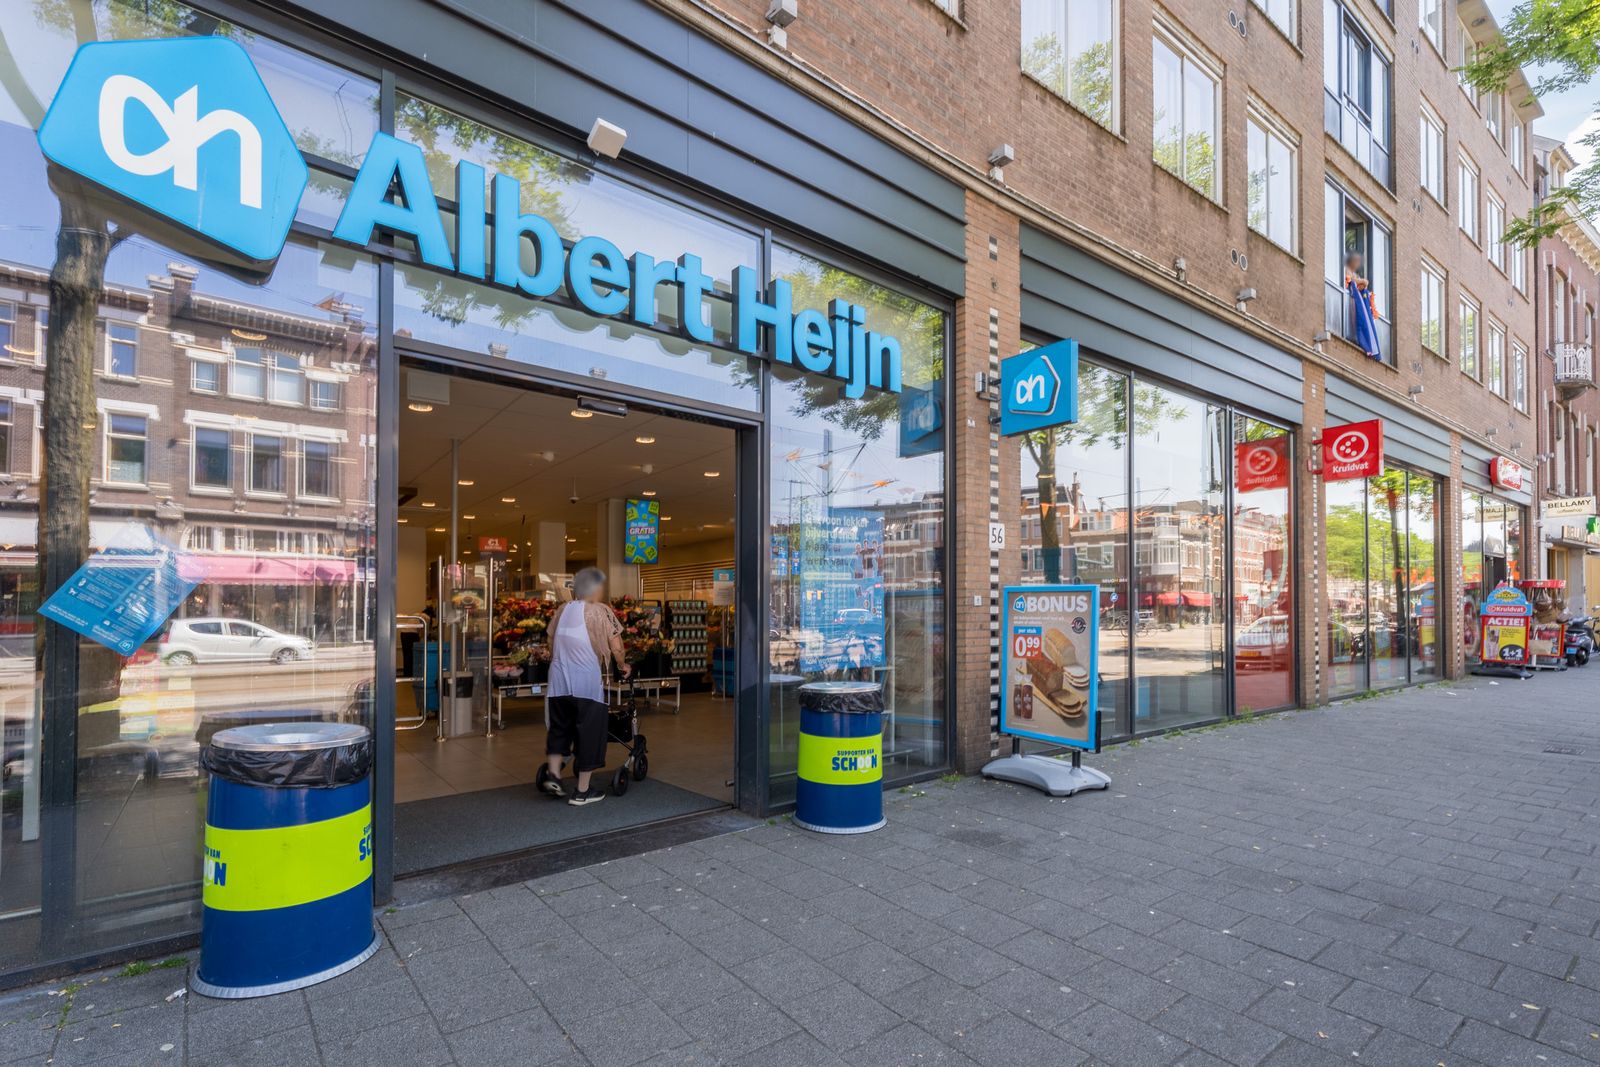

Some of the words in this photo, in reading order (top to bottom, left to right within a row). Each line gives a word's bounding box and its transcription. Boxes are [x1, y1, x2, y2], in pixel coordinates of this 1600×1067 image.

[332, 131, 714, 343] Albert
[733, 264, 903, 400] Heijn
[1332, 461, 1369, 473] Kruidvat
[1547, 499, 1592, 509] BELLAMY
[629, 526, 656, 536] GRATIS
[991, 527, 1003, 544] 56
[1027, 595, 1088, 612] BONUS
[1497, 606, 1525, 614] Kruidvat
[1487, 617, 1526, 627] ACTIE!
[1502, 647, 1523, 659] 1+1
[836, 749, 867, 757] SUPPORTER
[831, 754, 878, 772] SCHOON
